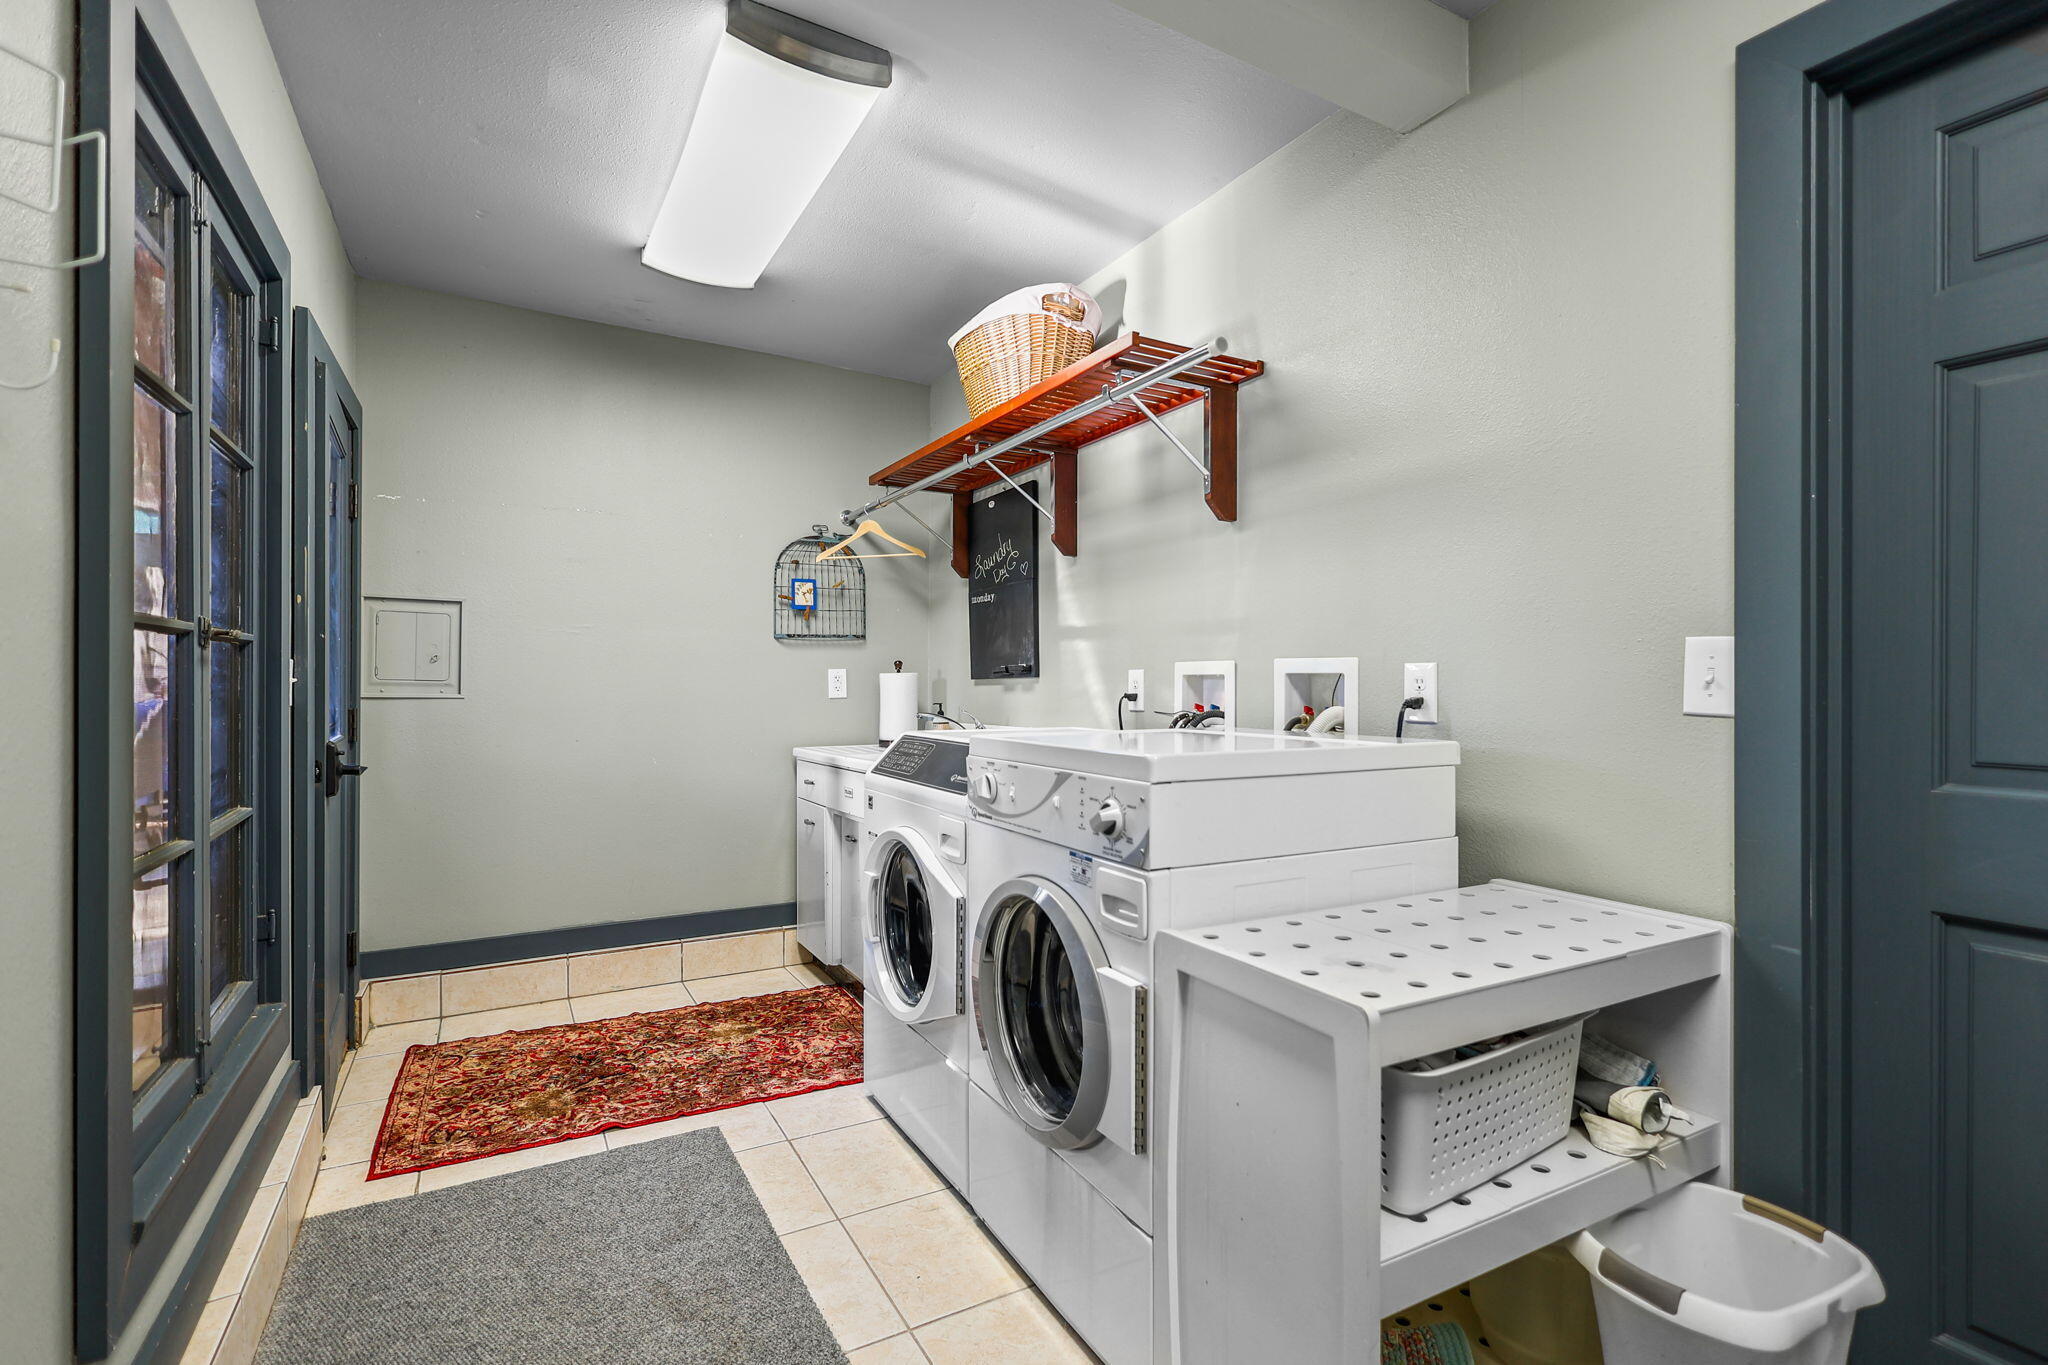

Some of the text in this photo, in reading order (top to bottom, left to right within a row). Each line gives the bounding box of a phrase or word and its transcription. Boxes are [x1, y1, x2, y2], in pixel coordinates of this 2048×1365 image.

[975, 532, 1019, 579] Laundry
[993, 564, 1009, 584] Day
[971, 593, 995, 603] monday
